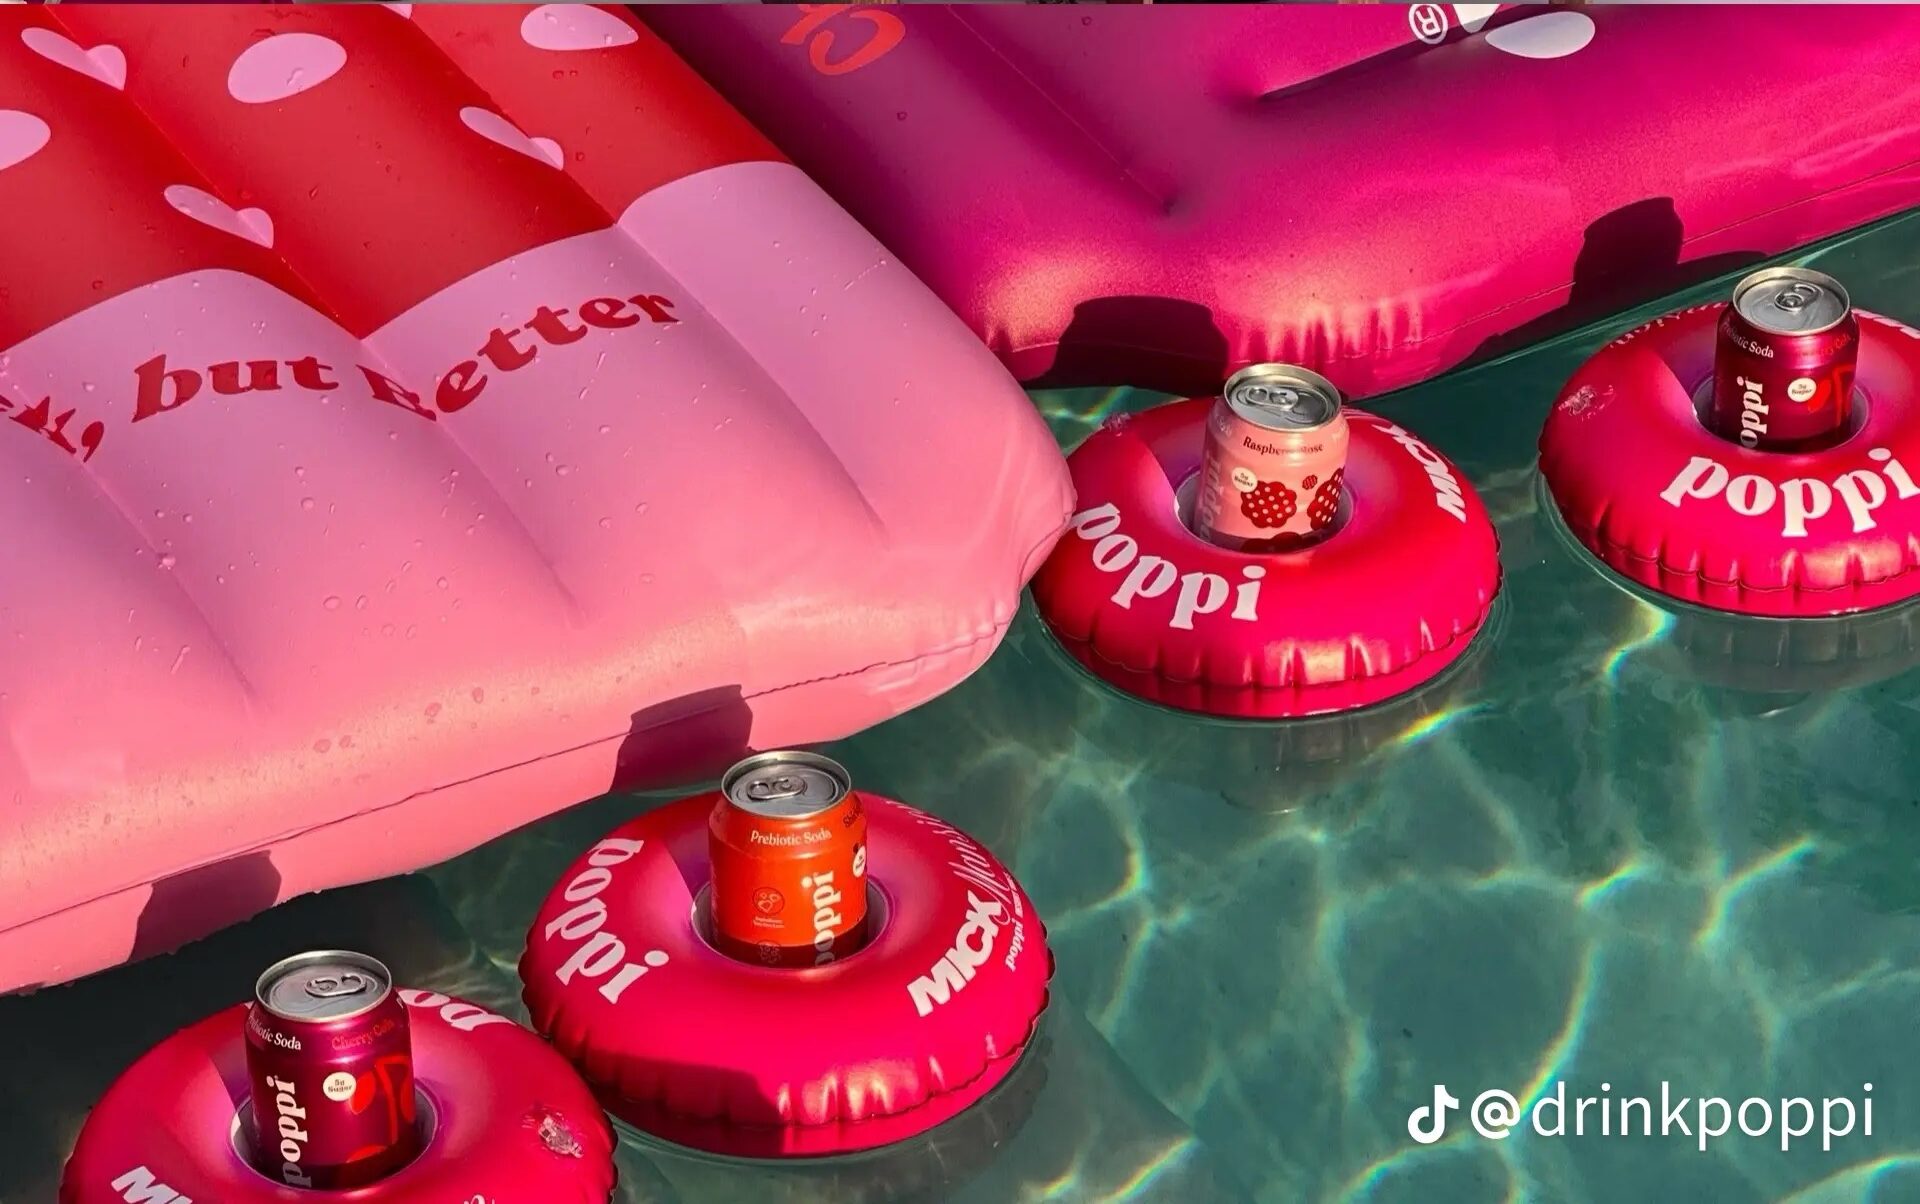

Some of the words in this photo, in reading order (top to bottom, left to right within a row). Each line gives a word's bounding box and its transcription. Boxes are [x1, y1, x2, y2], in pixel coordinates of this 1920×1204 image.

[131, 354, 340, 423] but
[1748, 340, 1774, 359] Soda
[1736, 375, 1770, 448] oppi
[1371, 424, 1467, 524] MICK
[1659, 448, 1920, 537] poppi
[1070, 502, 1267, 630] poppi
[750, 829, 801, 848] Prebiotic
[803, 827, 832, 844] Soda
[545, 837, 670, 1004] poppi
[906, 889, 1002, 1017] MICK
[274, 1032, 302, 1050] Soda
[266, 1074, 312, 1188] poppi
